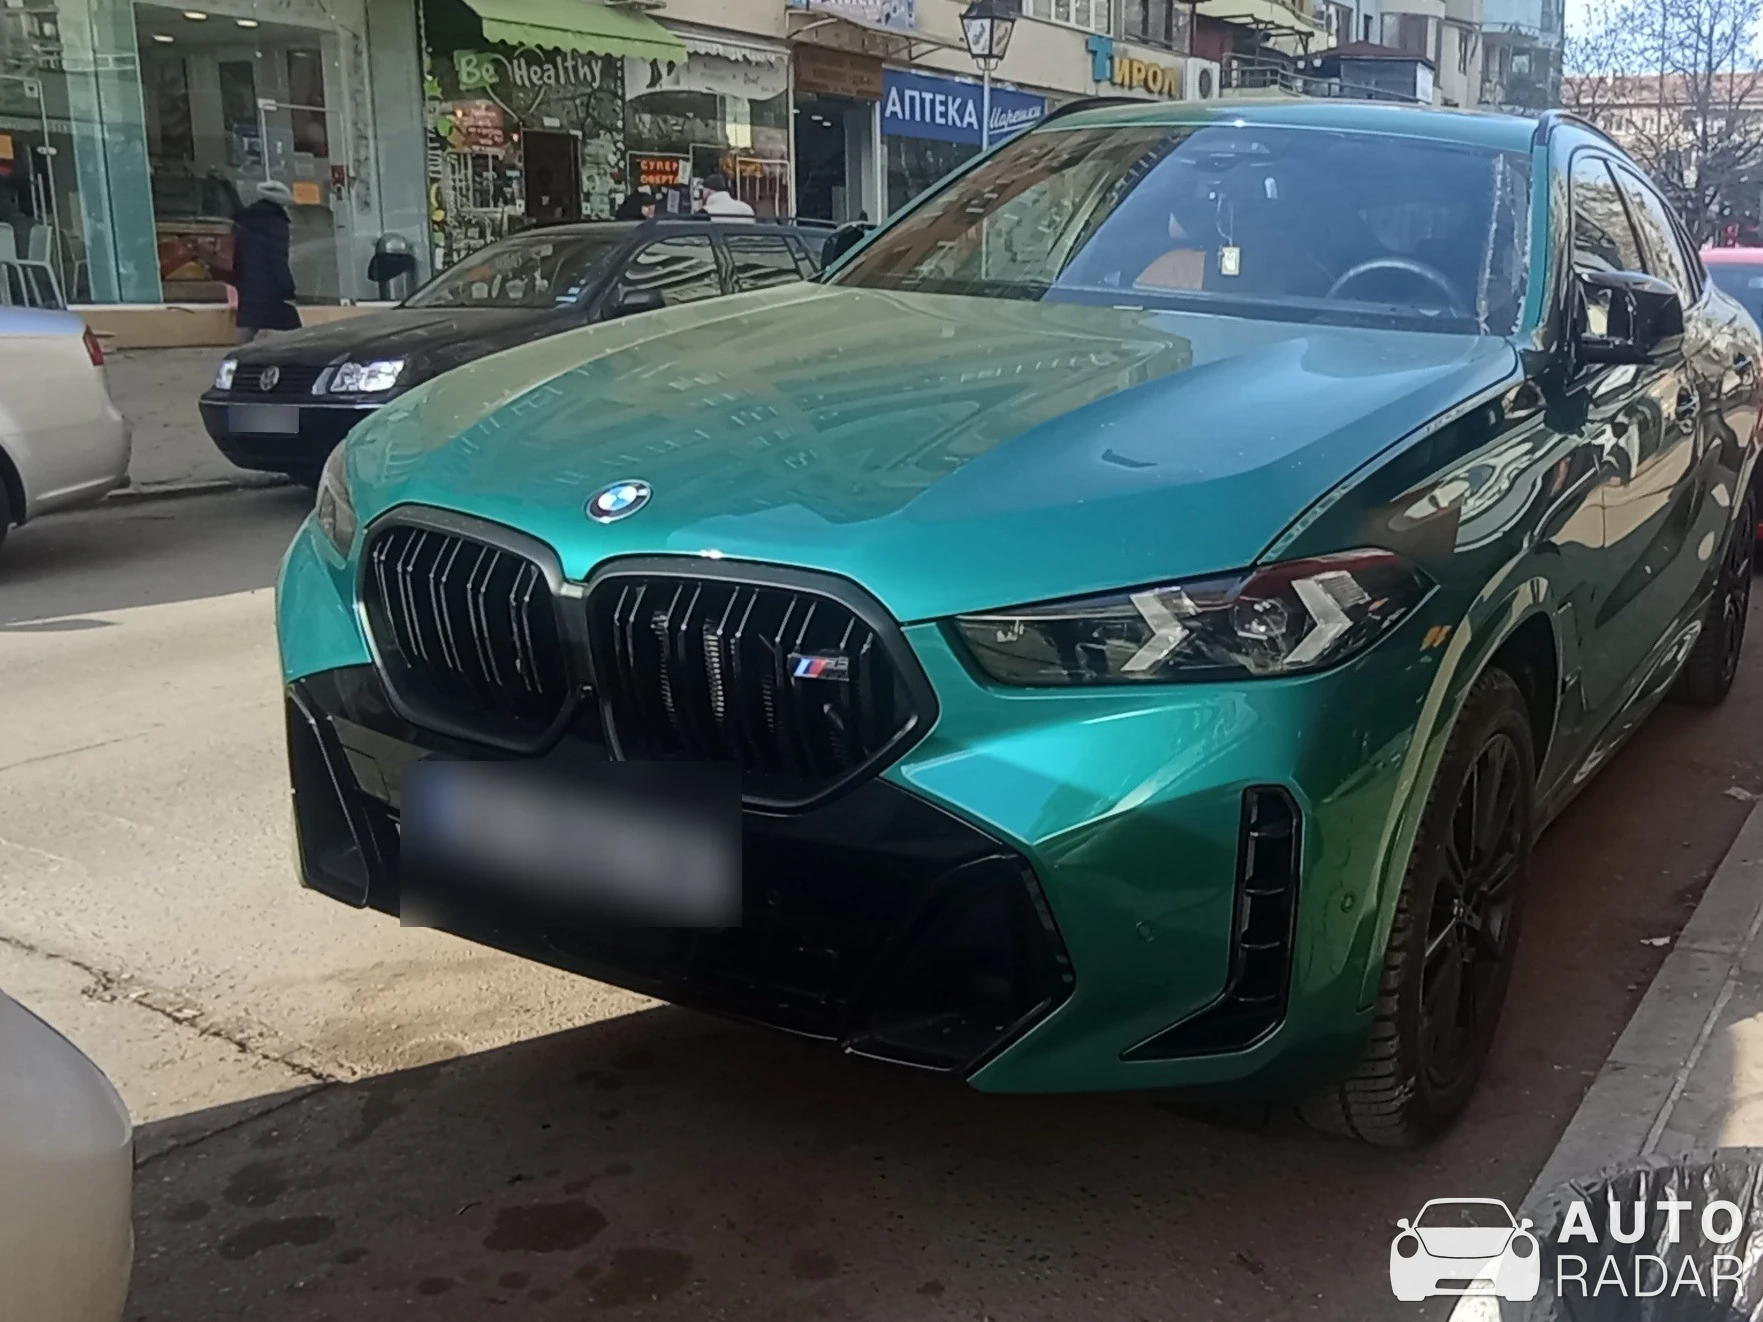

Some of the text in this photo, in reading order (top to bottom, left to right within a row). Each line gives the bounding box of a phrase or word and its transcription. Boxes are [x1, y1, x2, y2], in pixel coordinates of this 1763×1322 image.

[460, 52, 602, 89] Be Healthy
[885, 86, 979, 130] АПТЕКА
[640, 159, 678, 171] СУПЕР
